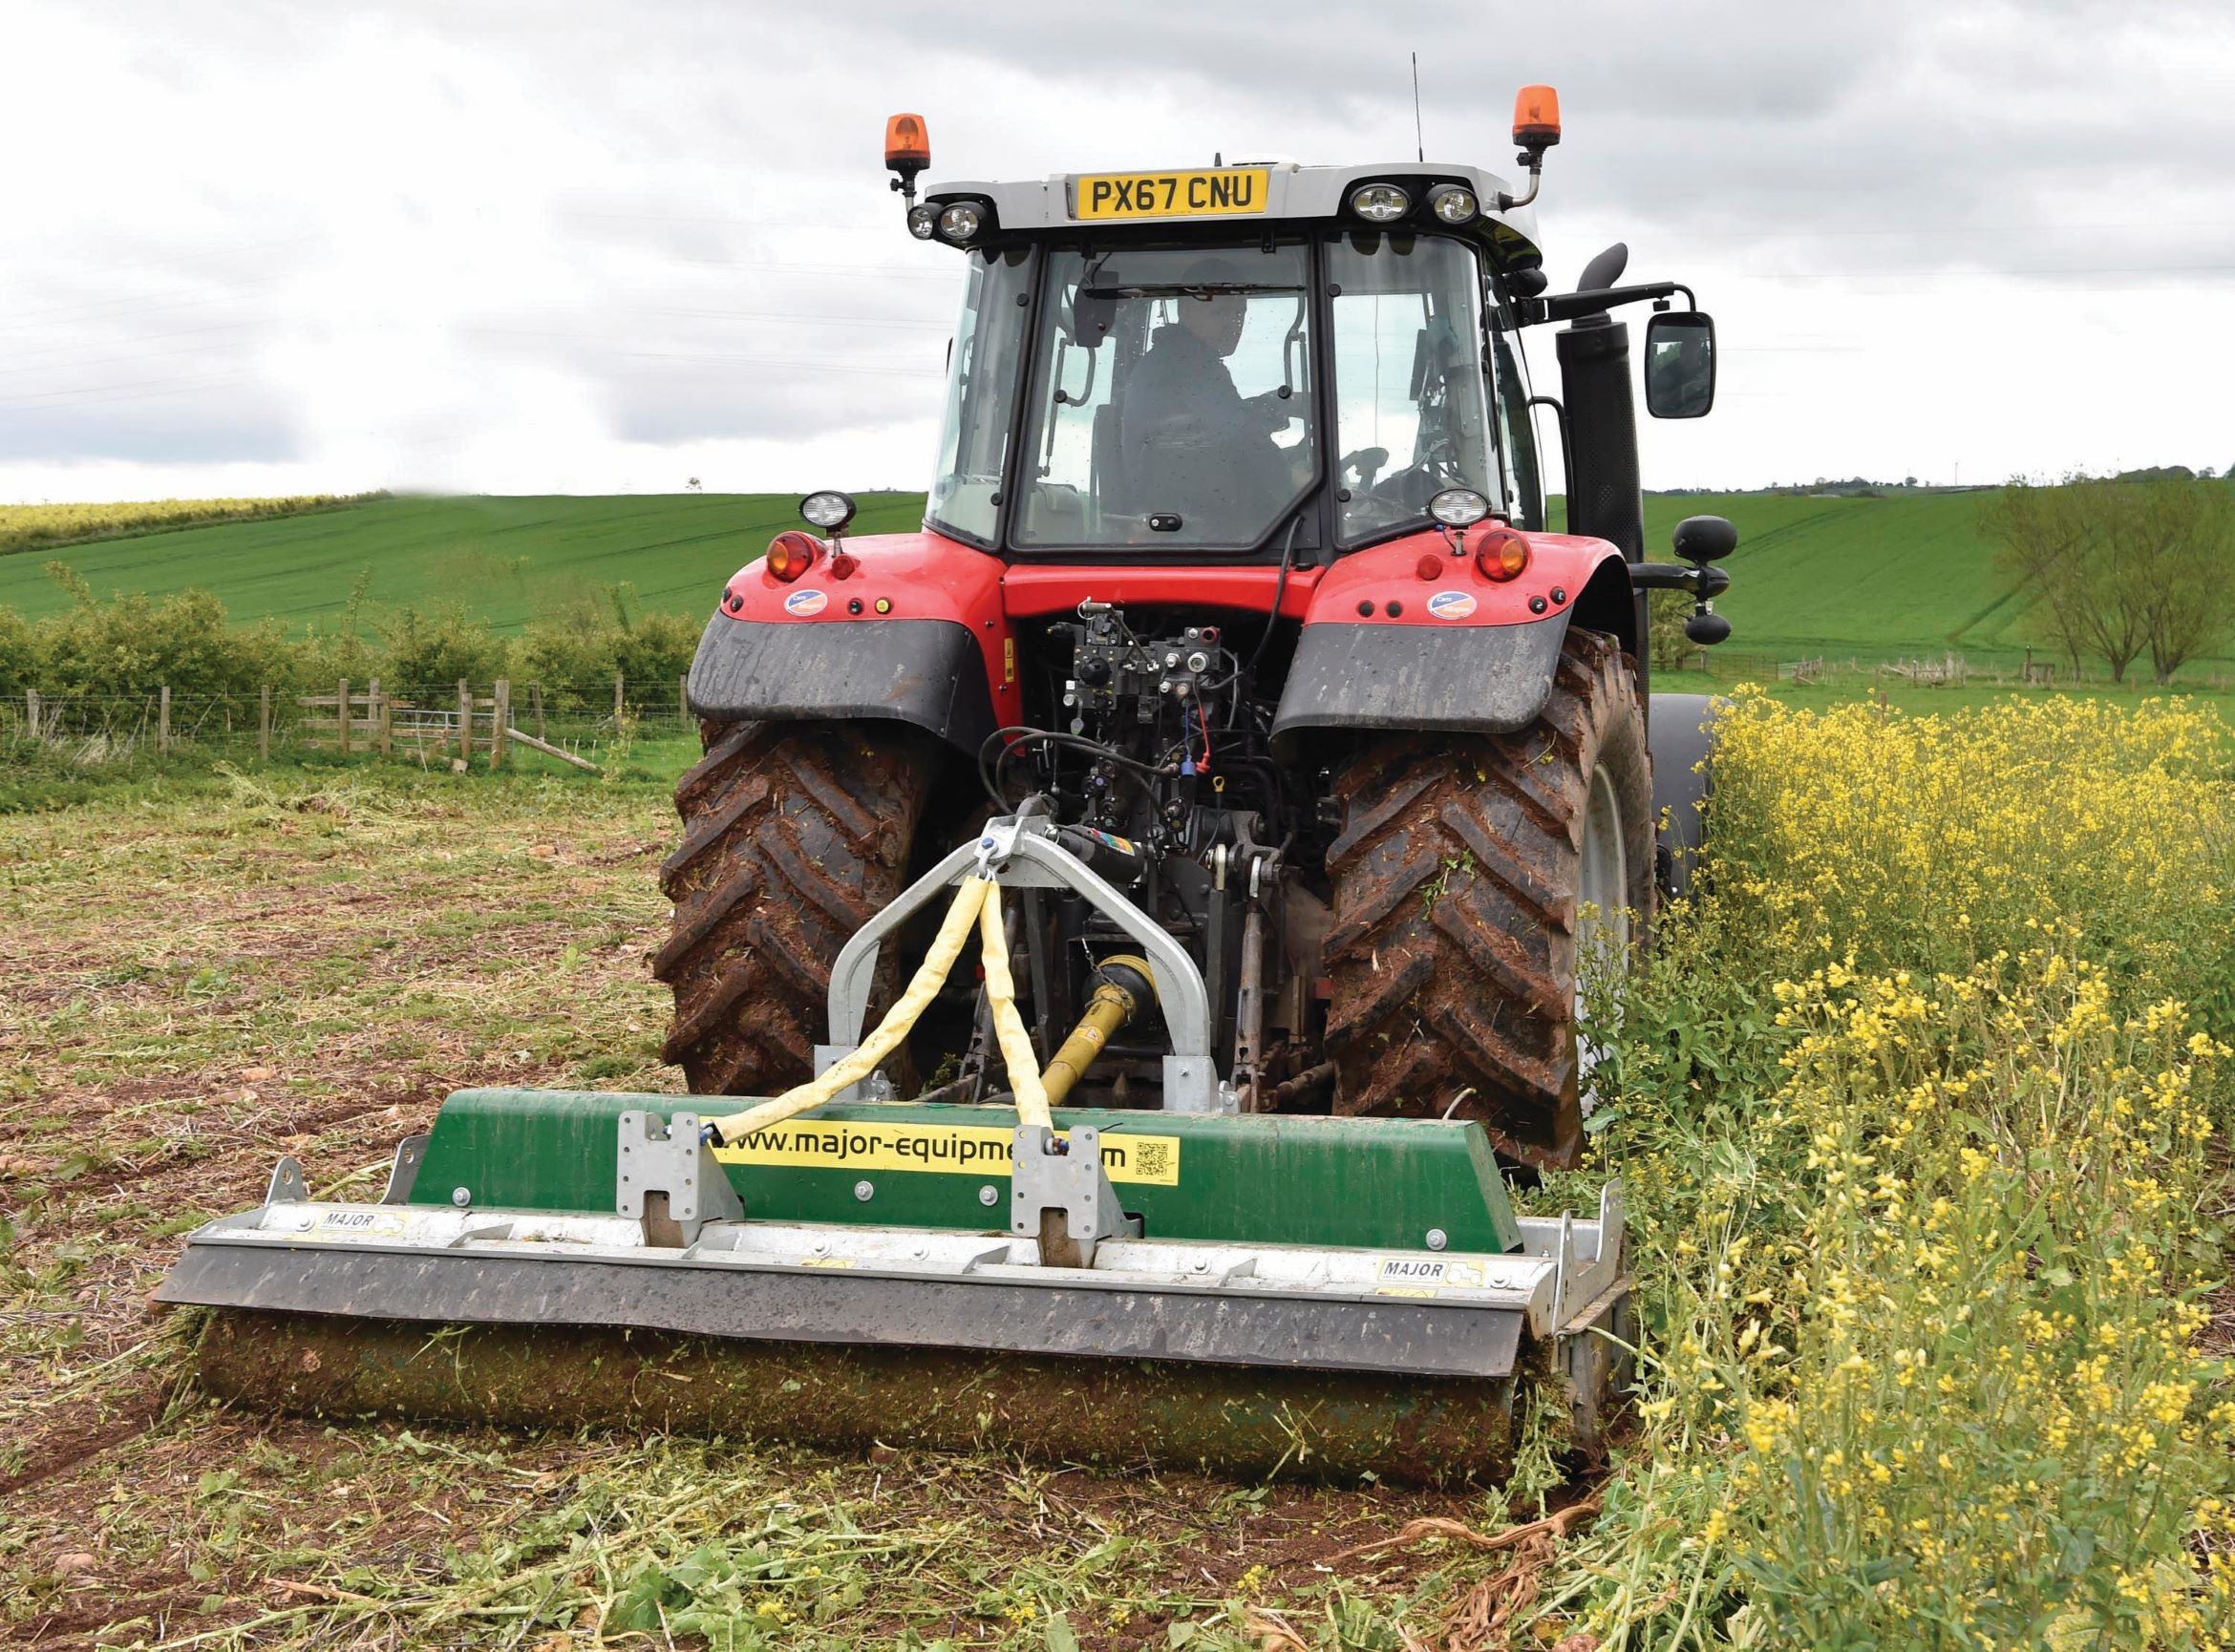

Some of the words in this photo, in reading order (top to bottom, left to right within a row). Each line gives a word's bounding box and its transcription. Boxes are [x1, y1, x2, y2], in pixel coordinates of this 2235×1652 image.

[1093, 178, 1177, 212] PX67
[1188, 176, 1251, 208] CNU
[325, 1213, 374, 1226] MAJOR
[1384, 1261, 1443, 1277] MAJOR
